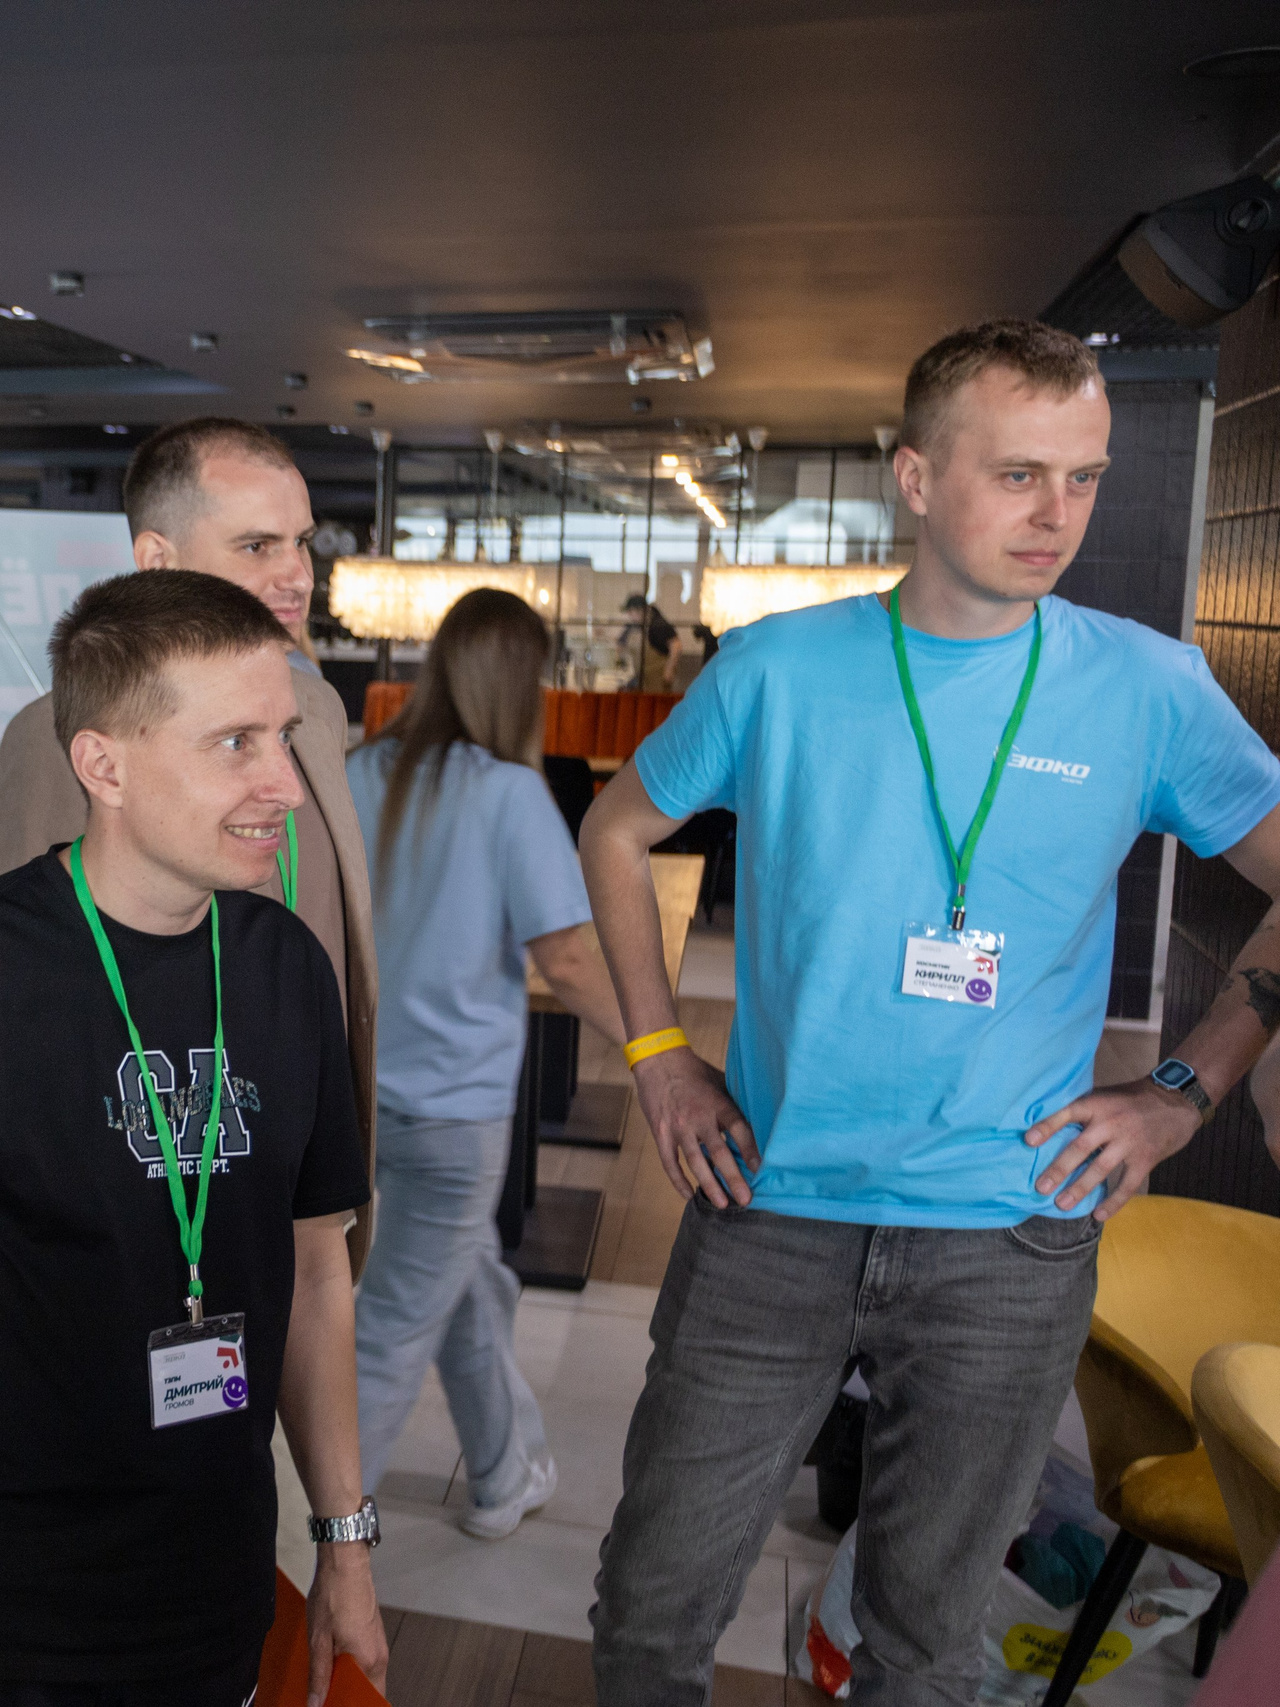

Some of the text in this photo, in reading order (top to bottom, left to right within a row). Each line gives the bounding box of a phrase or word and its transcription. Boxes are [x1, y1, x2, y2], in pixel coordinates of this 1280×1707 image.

[914, 968, 966, 984] КИРИЛЛ
[196, 1158, 231, 1175] DPT.
[163, 1375, 224, 1402] ДМИТРИЙ
[164, 1398, 195, 1411] ГРОМОВ
